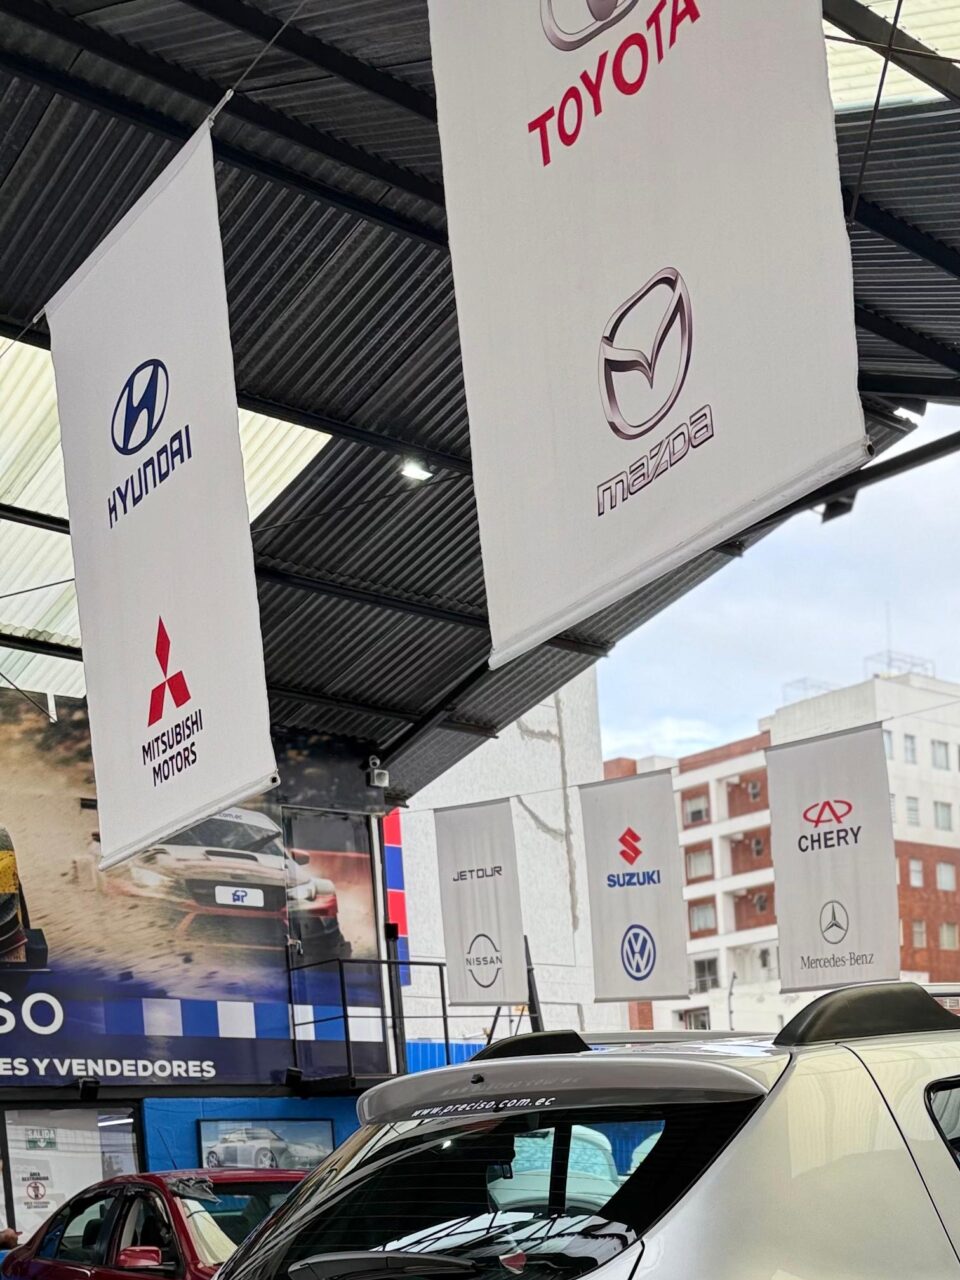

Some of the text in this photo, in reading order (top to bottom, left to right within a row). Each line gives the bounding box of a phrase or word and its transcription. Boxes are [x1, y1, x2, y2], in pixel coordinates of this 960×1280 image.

[528, 0, 701, 167] TOYOTA
[597, 404, 715, 517] mazda
[107, 425, 193, 529] HYUNDAI
[141, 709, 204, 765] MITSUBISHI
[152, 753, 198, 787] MOTORS
[797, 826, 862, 853] CHERY
[452, 865, 502, 882] JETOUR
[606, 869, 661, 888] SUZUKI
[465, 955, 503, 966] NISSAN
[800, 951, 874, 970] Mercedes-Benz
[32, 1058, 50, 1076] Y
[52, 1059, 216, 1078] VENDEDORES
[411, 1096, 556, 1117] www.preciso.com.ec
